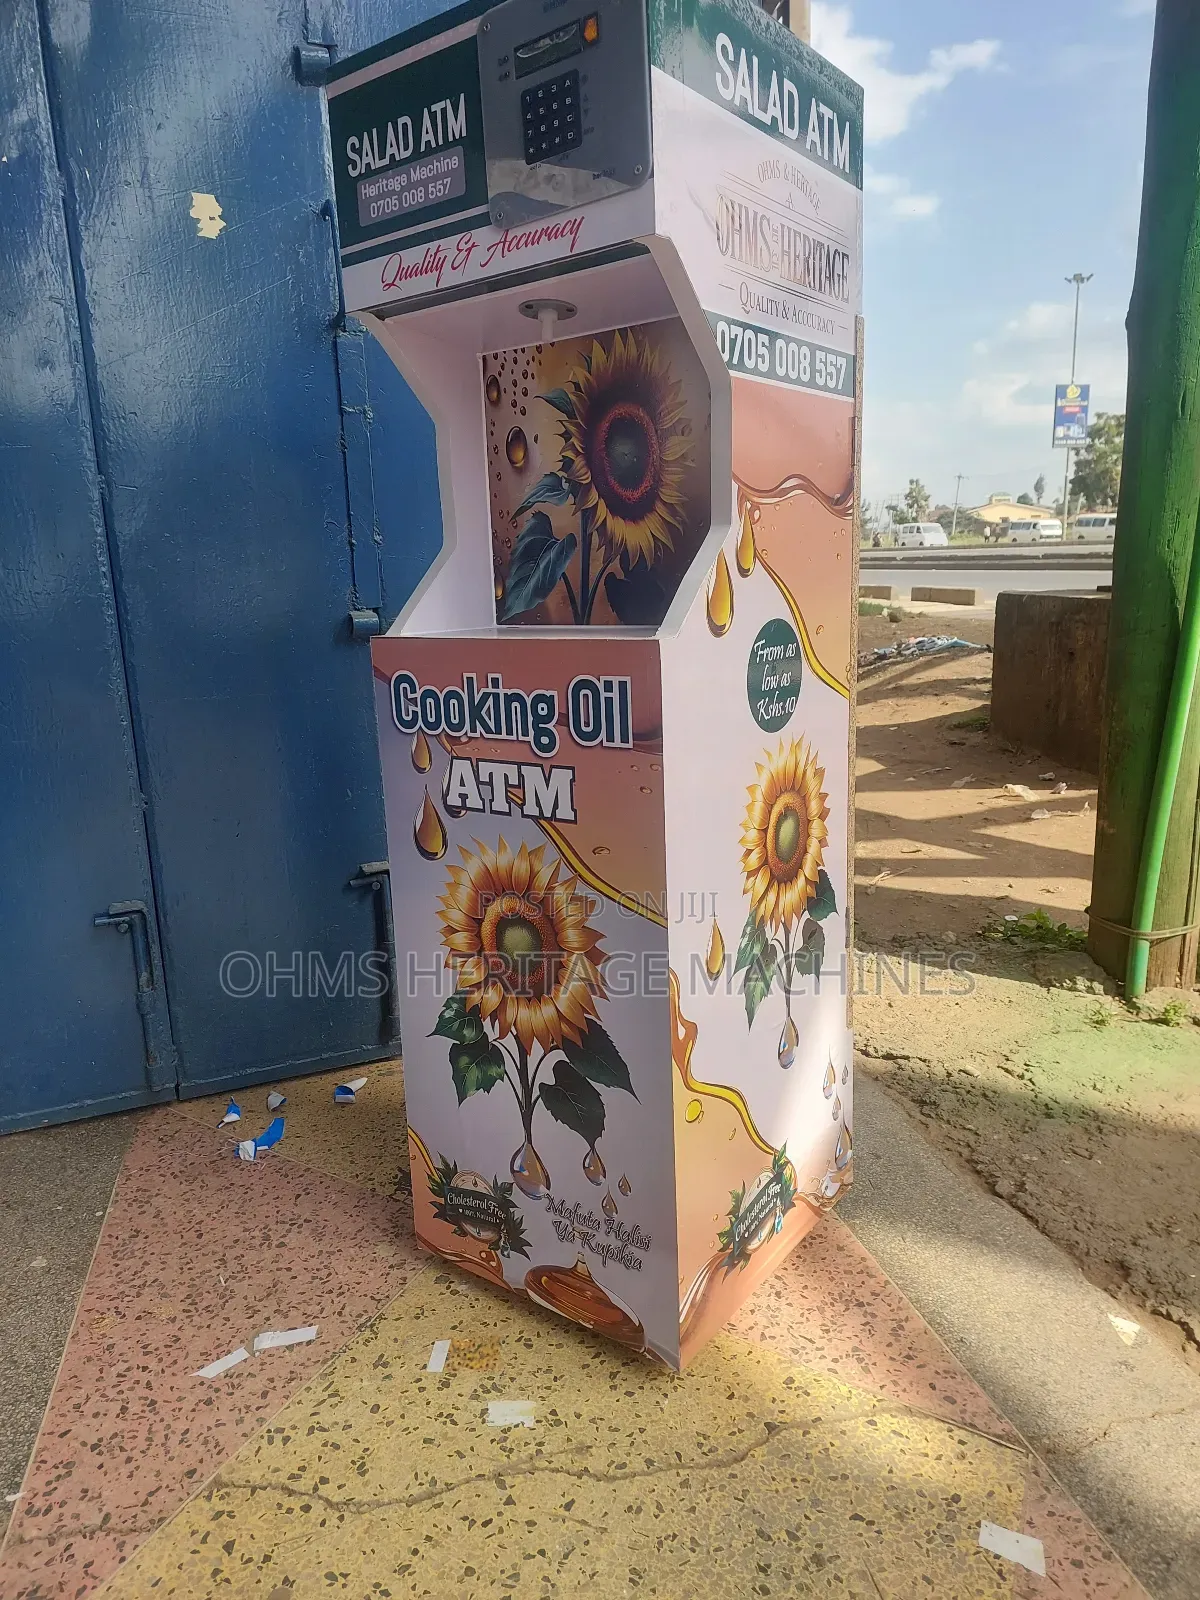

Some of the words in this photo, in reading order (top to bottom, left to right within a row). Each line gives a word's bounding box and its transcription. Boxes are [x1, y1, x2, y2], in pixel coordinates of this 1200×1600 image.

[716, 32, 800, 140] SALAD
[805, 97, 850, 174] ATM
[346, 115, 414, 178] SALAD
[420, 92, 467, 152] ATM
[361, 172, 408, 201] Heritage
[411, 154, 459, 184] Machine
[370, 194, 399, 219] 0705
[402, 187, 425, 210] 008
[428, 177, 451, 200] 557
[381, 244, 447, 292] Quality
[480, 215, 585, 268] Accuracy
[715, 193, 772, 273] OHMS
[780, 222, 850, 304] HERITAGE
[781, 299, 790, 321] &
[716, 320, 770, 373] 0705
[775, 338, 811, 383] 008
[815, 349, 847, 390] 557
[754, 639, 784, 664] From
[785, 641, 797, 658] as
[761, 663, 779, 692] low
[780, 670, 792, 688] as
[390, 669, 559, 759] Cooking
[567, 673, 634, 749] Oil
[446, 756, 578, 825] ATM
[447, 1192, 487, 1210] Cholesterol
[487, 1200, 507, 1221] Free
[544, 1192, 602, 1232] Mafuta
[604, 1217, 653, 1251] Halisi
[552, 1219, 576, 1243] Ya
[580, 1230, 643, 1272] Kupikia
